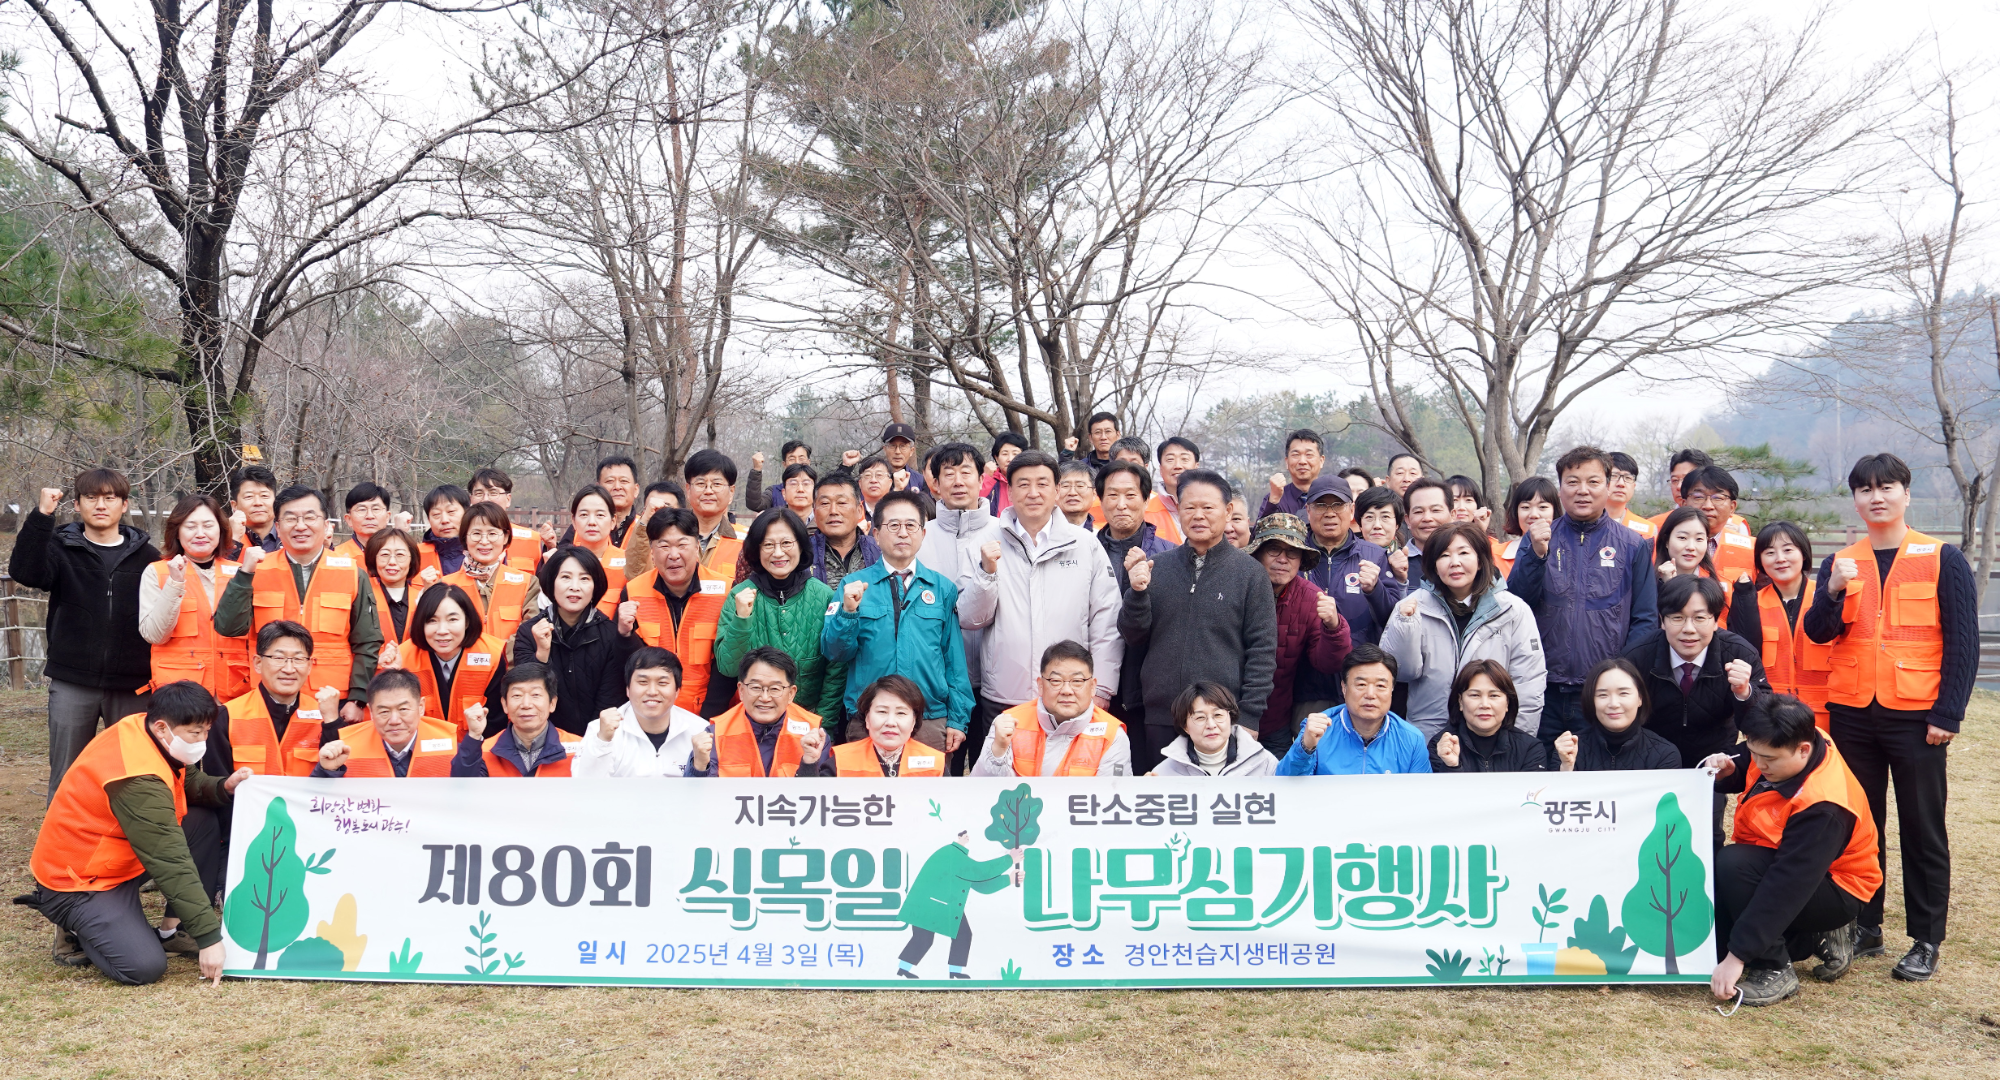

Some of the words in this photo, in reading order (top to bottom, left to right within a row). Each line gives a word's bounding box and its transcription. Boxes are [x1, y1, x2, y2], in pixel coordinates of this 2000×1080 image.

[310, 796, 354, 815] 희망찬
[734, 794, 896, 827] 지속가능한
[1068, 793, 1198, 826] 탄소중립
[1210, 792, 1276, 825] 실현
[1543, 801, 1616, 825] 광주시
[334, 815, 379, 835] 행복도시
[381, 816, 410, 834] 광주!
[418, 841, 652, 908] 제80회
[677, 847, 907, 931] 식목일
[1022, 842, 1510, 932] 나무심기행사
[646, 942, 728, 966] 2025년
[736, 943, 773, 967] 4월
[781, 943, 818, 967] 3일
[827, 943, 864, 968] (목)
[1124, 942, 1336, 967] 경안천습지생태공원
